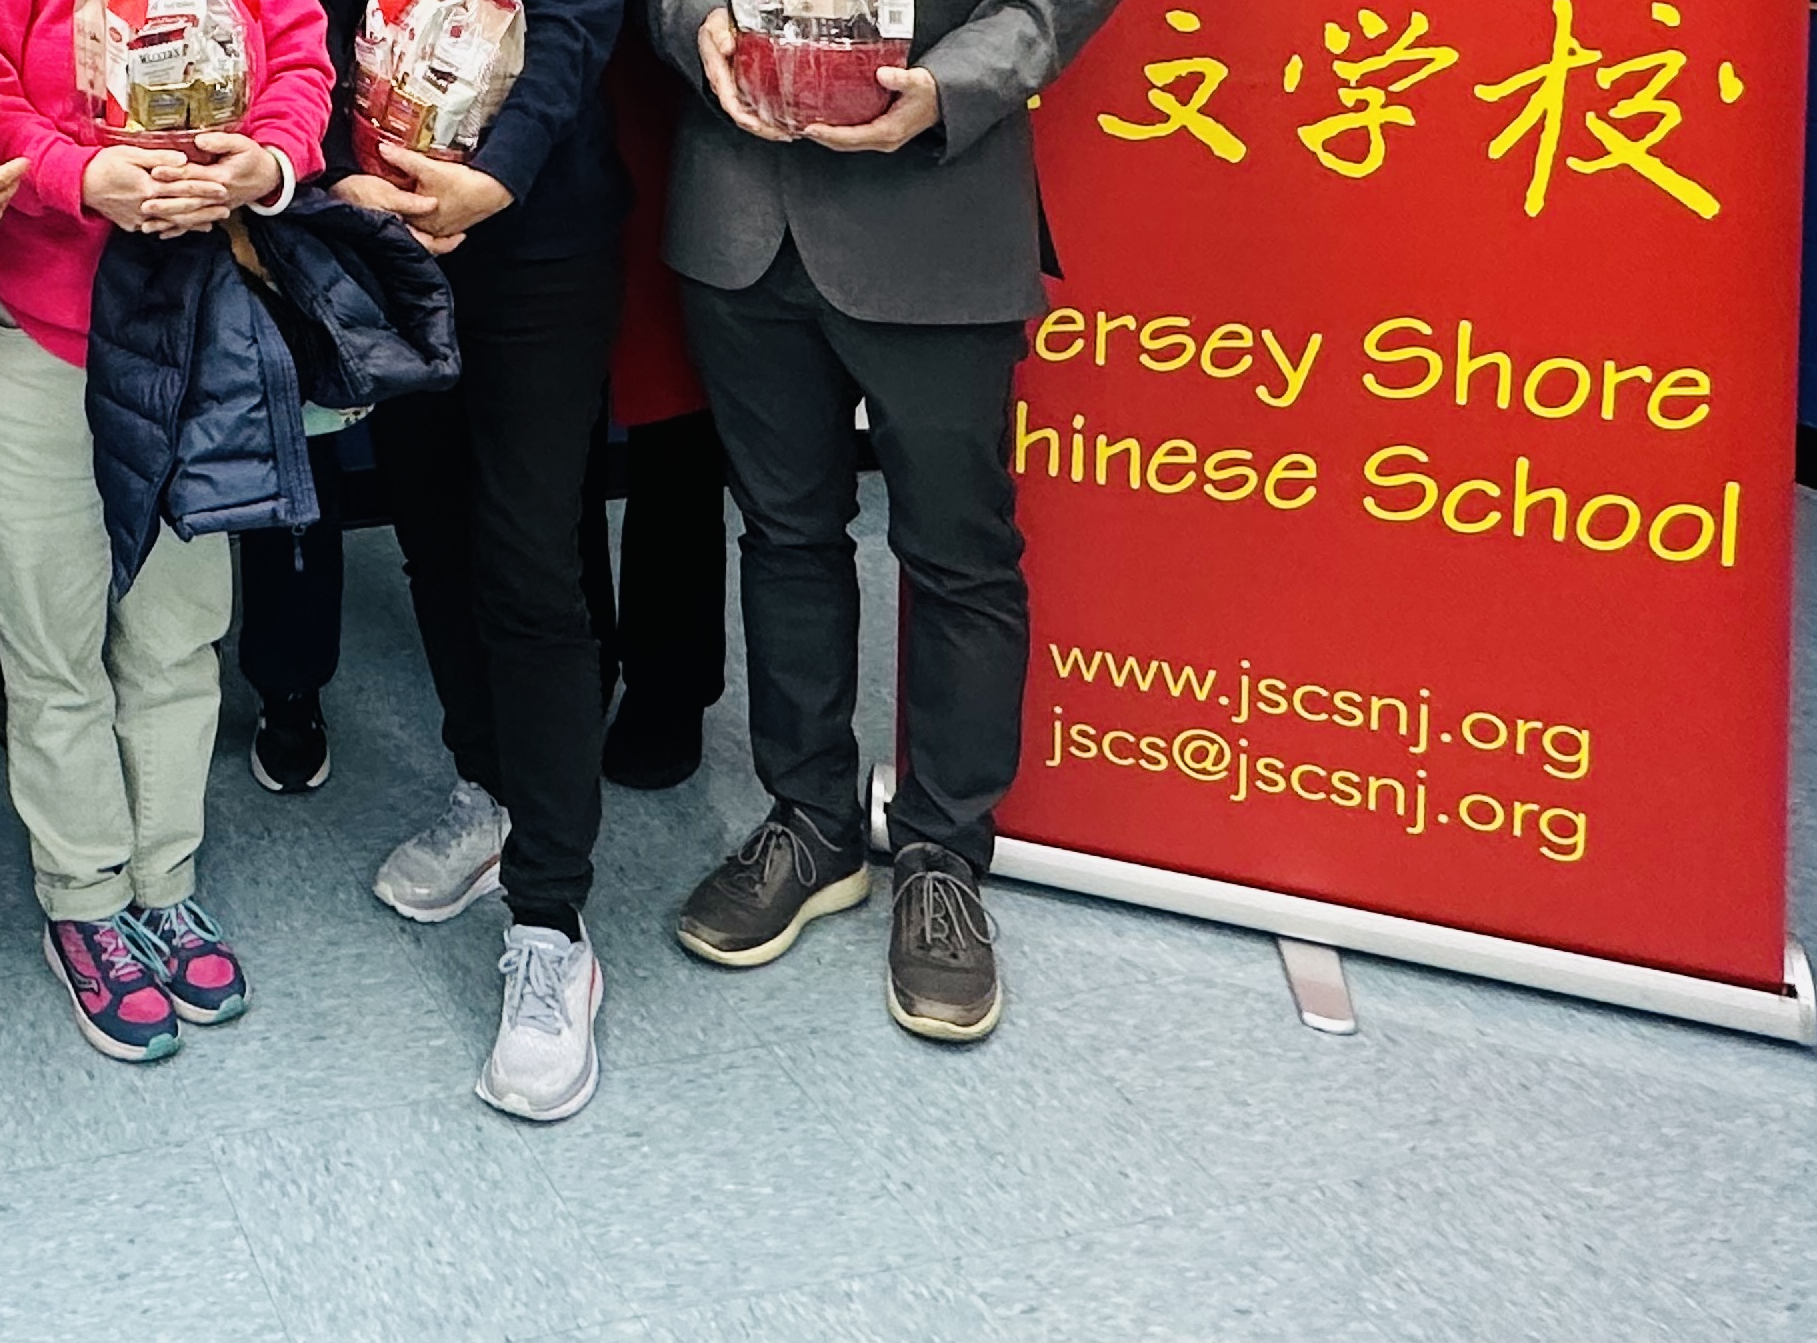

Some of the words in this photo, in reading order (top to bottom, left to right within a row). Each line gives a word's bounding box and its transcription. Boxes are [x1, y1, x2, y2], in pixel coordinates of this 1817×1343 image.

[1034, 304, 1323, 408] ersey
[1362, 317, 1711, 432] Shore
[1013, 401, 1318, 510] hinese
[1363, 444, 1741, 567] School
[1046, 706, 1588, 862] jscs@jscsnj.org
[1049, 641, 1591, 780] www.jscsnj.org
